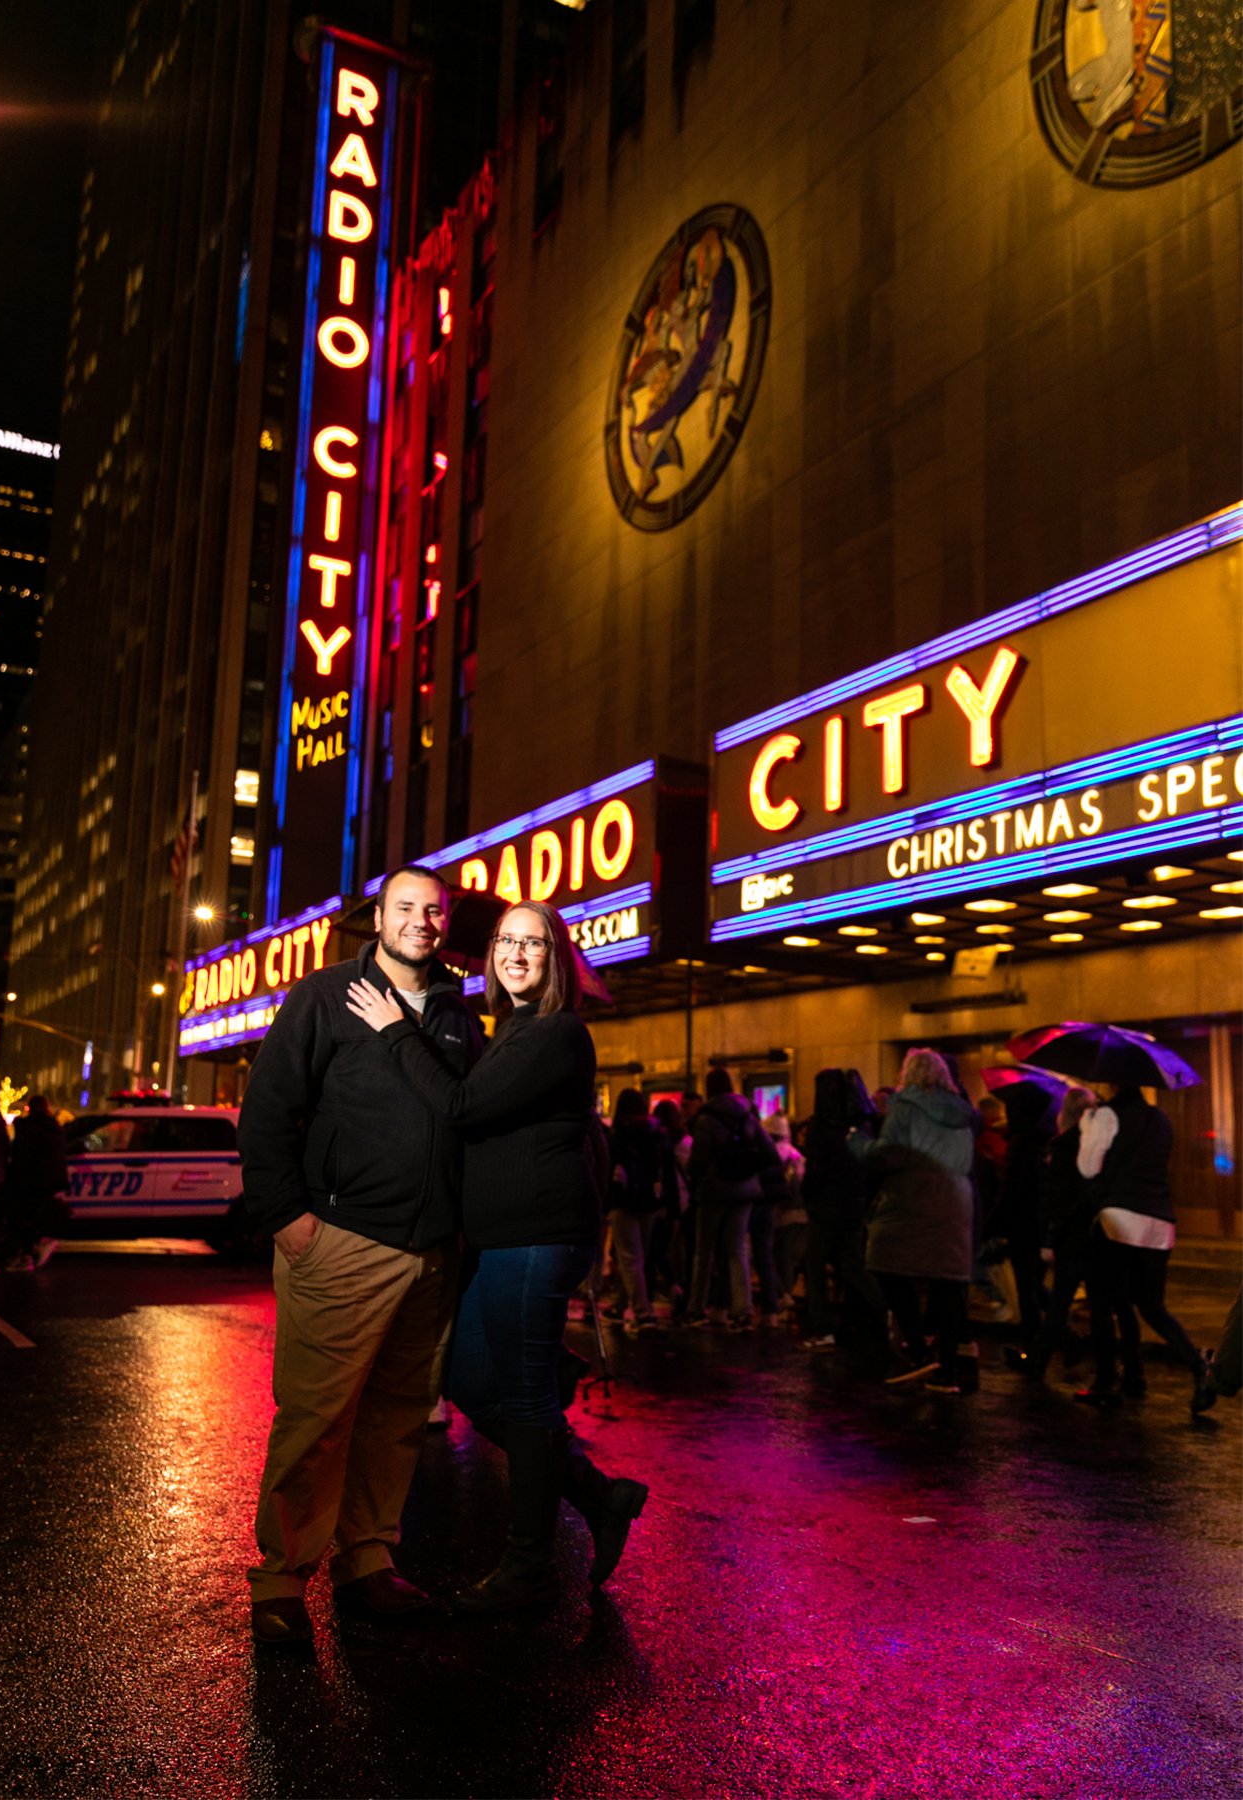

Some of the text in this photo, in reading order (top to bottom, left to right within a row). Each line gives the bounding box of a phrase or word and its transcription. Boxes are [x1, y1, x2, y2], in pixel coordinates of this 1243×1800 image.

[300, 68, 379, 675] RADIO CITY
[749, 647, 1018, 831] CITY
[887, 790, 1103, 878] CHRISTMAS
[194, 948, 256, 1012] RADIO
[265, 917, 331, 987] CITY
[66, 1171, 144, 1197] NYPD
